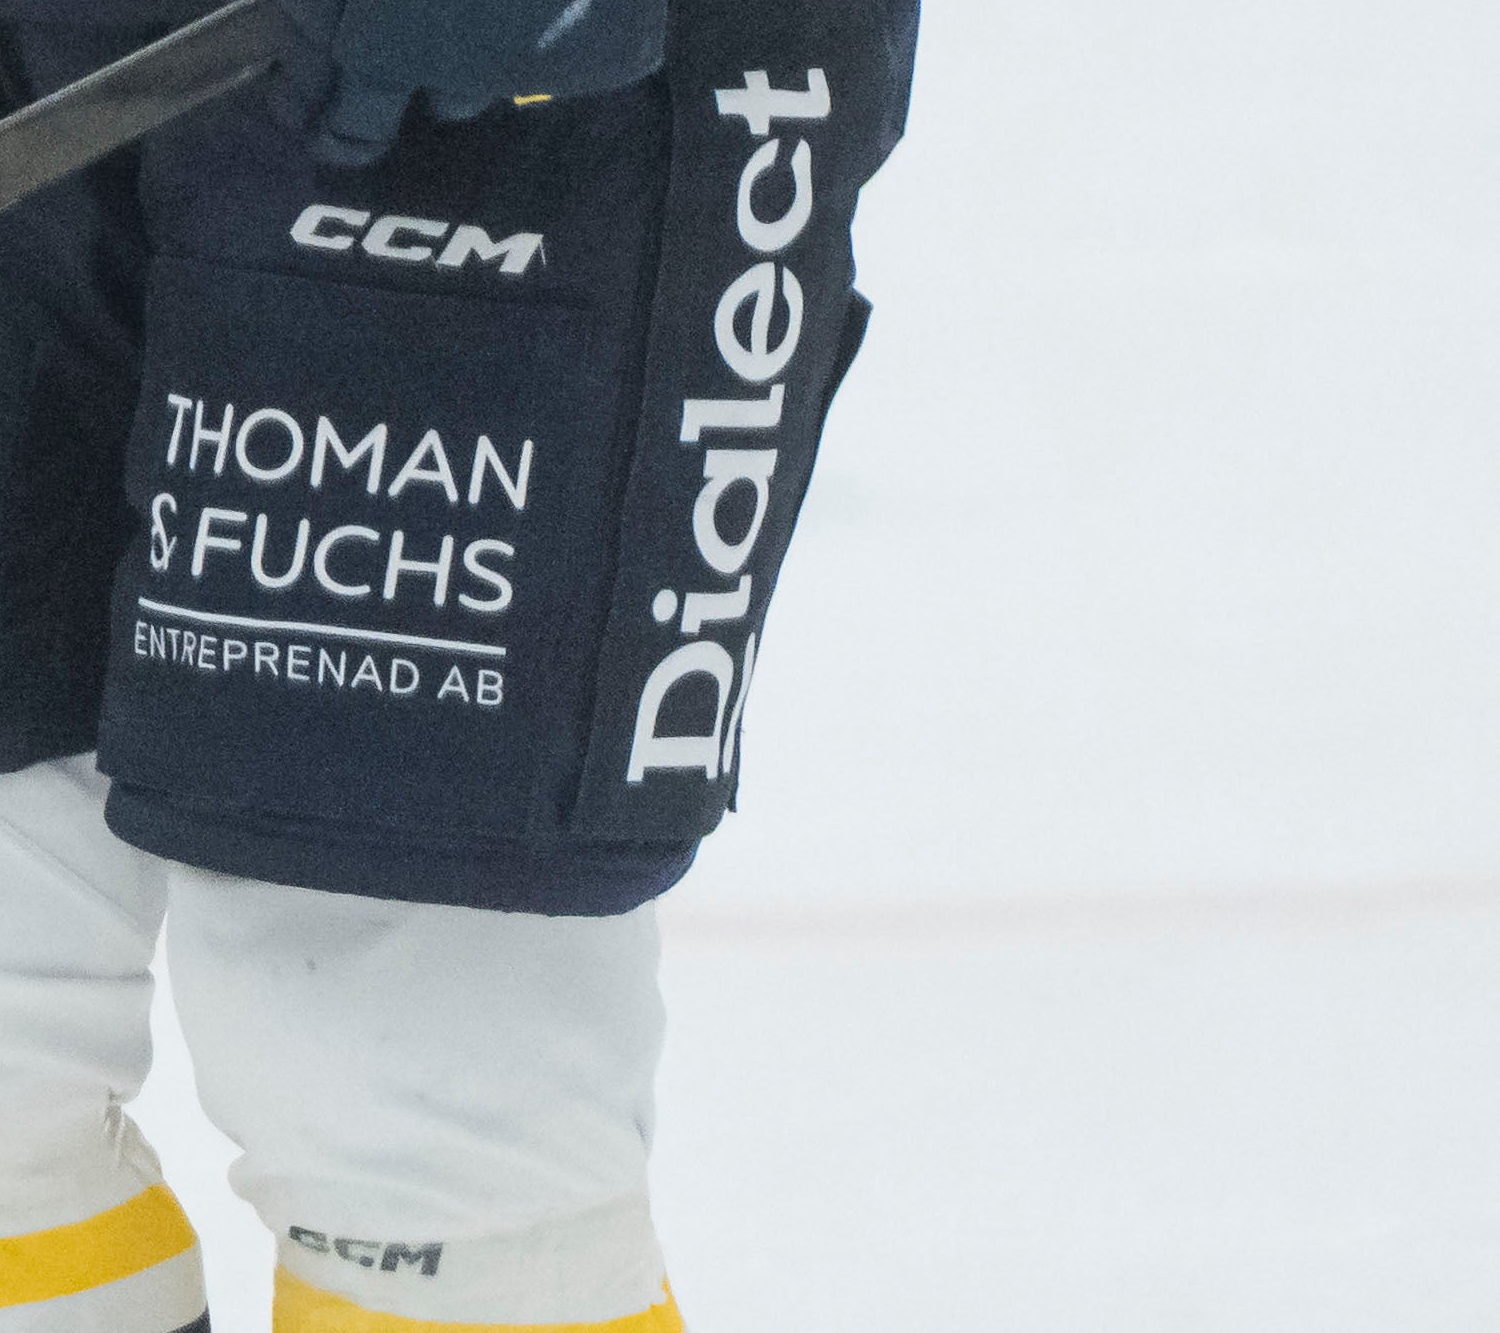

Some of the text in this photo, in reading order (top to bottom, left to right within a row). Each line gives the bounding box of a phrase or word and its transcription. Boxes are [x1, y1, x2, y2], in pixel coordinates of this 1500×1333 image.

[289, 202, 547, 274] CCM
[167, 392, 534, 511] THOMAN
[626, 68, 833, 783] Dialect
[150, 491, 516, 613] & FUCHS
[133, 620, 505, 707] ENTREPRENAD AB
